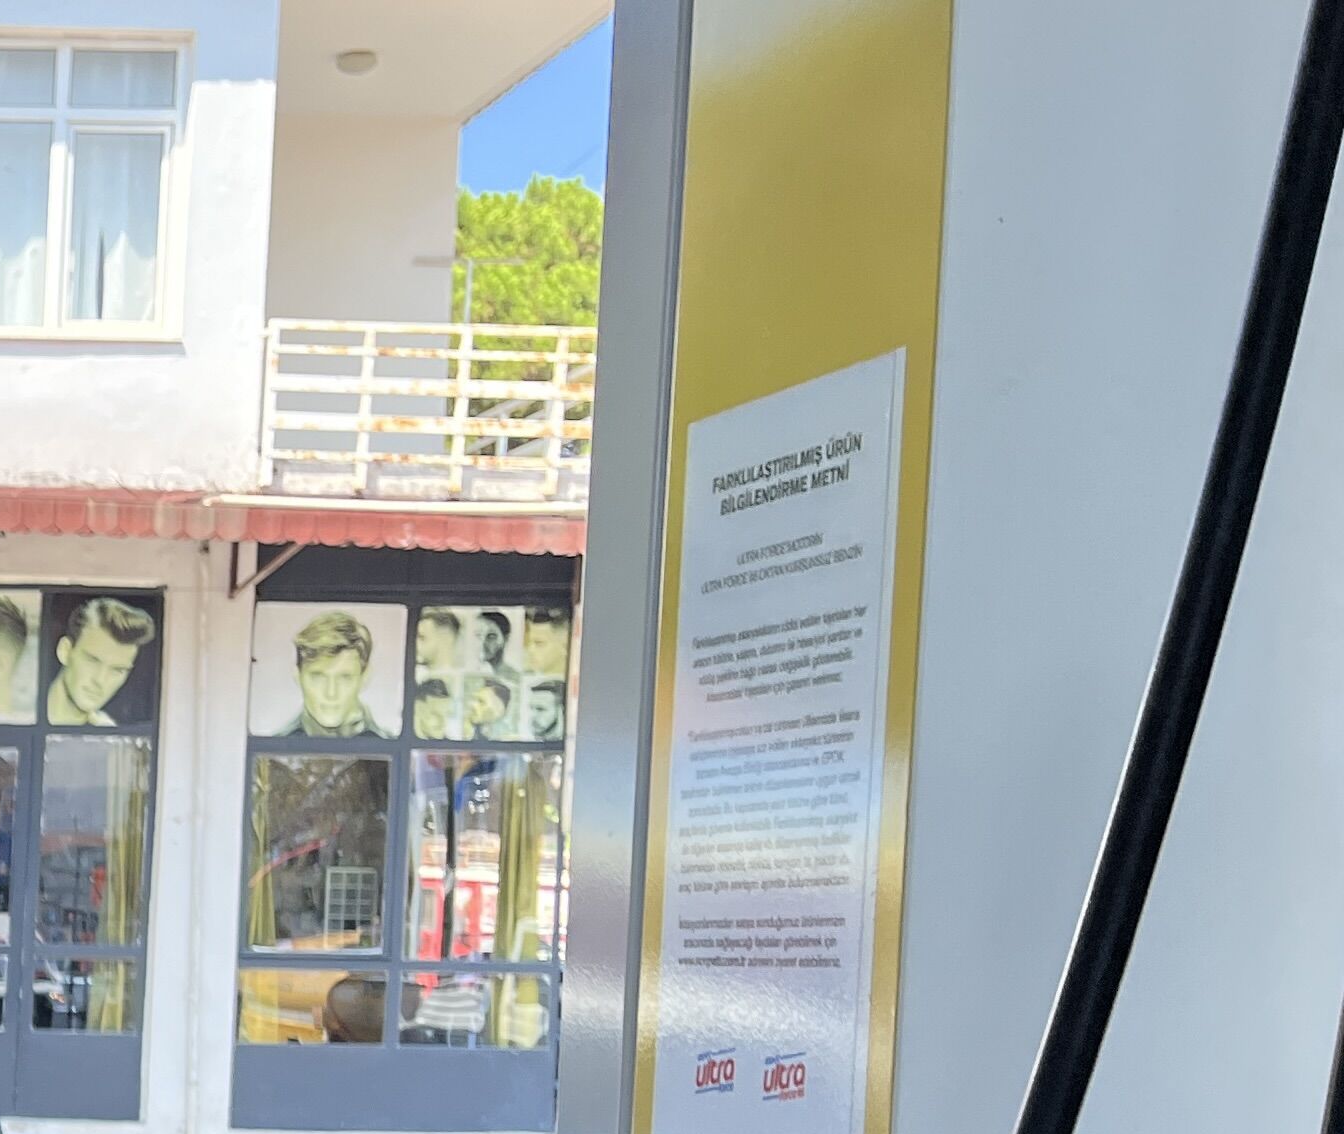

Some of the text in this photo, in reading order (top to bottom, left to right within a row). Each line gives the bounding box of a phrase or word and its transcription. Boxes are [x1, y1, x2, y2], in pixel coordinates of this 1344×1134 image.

[826, 432, 863, 460] ÜRÜN
[720, 459, 850, 516] BİLGİLENDİRME METNİ
